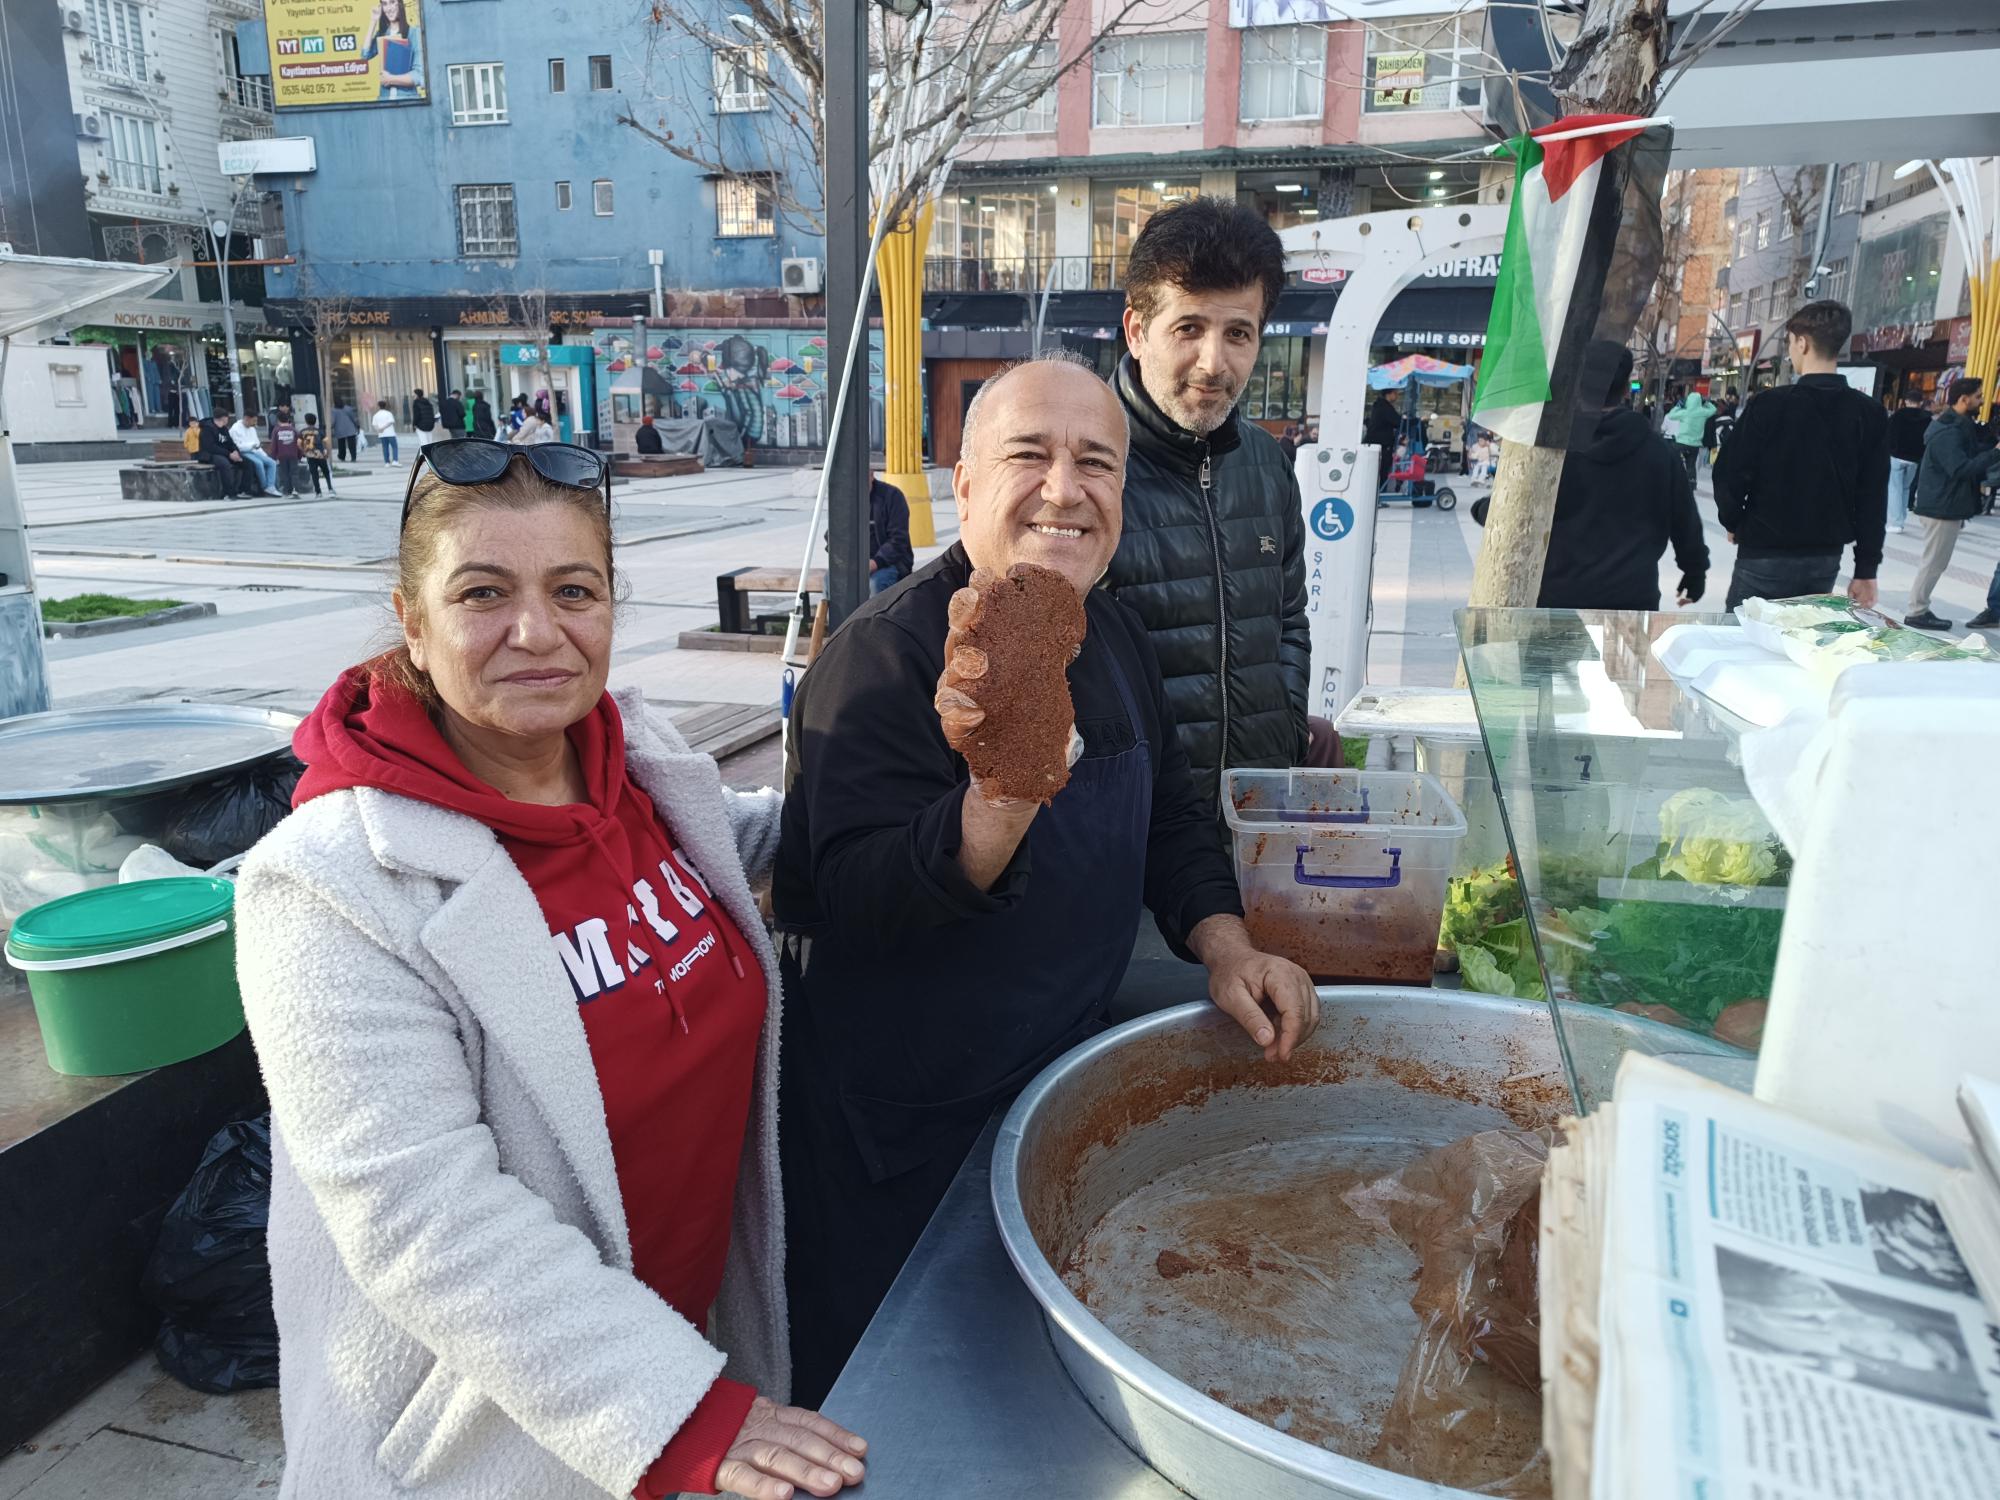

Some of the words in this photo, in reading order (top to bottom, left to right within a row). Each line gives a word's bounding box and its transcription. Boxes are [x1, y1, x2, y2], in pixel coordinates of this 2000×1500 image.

[278, 39, 298, 54] TYT
[304, 38, 323, 52] AYT
[334, 35, 355, 51] LGS
[345, 62, 368, 74] Ediyor
[114, 312, 155, 326] NOKTA
[350, 311, 391, 325] SCARF
[549, 310, 570, 324] SRC
[1392, 330, 1444, 346] ŞEHİR
[1311, 551, 1323, 613] ŞARJ
